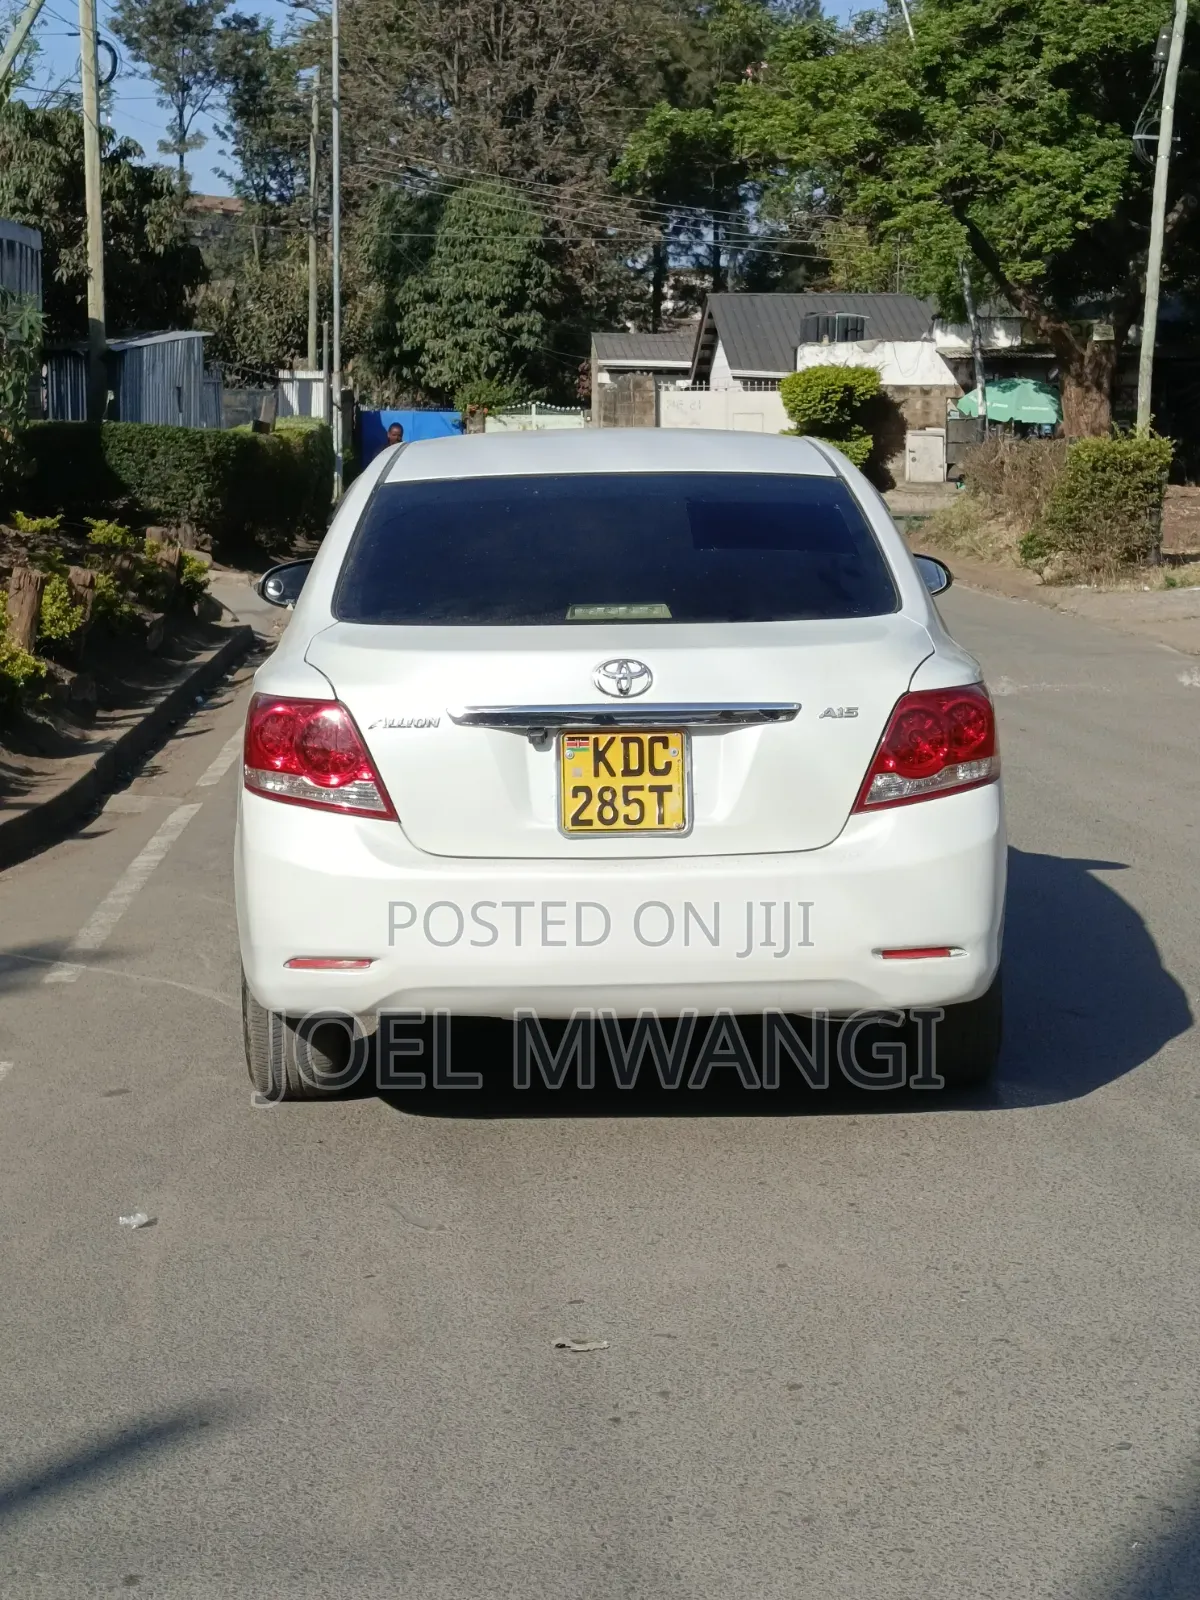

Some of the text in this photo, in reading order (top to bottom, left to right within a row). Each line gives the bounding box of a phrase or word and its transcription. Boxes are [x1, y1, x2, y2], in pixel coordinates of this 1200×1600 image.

[368, 717, 441, 729] ALLION
[819, 706, 859, 719] A15
[593, 736, 672, 777] KDC
[570, 784, 673, 826] 285T
